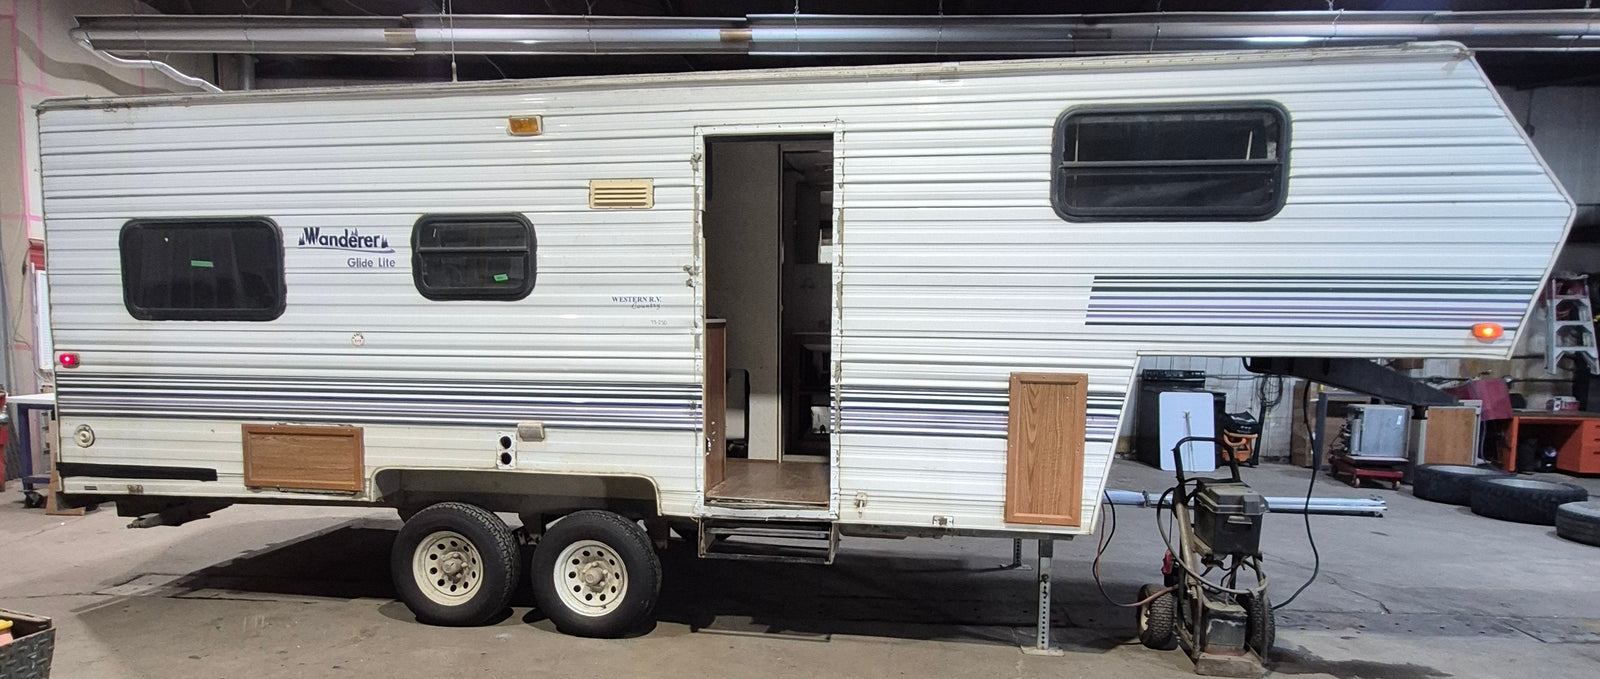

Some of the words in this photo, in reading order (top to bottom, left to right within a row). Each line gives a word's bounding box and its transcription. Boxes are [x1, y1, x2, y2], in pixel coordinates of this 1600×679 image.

[303, 227, 380, 248] Wanderer
[347, 257, 373, 268] Glide
[378, 257, 395, 268] Lite
